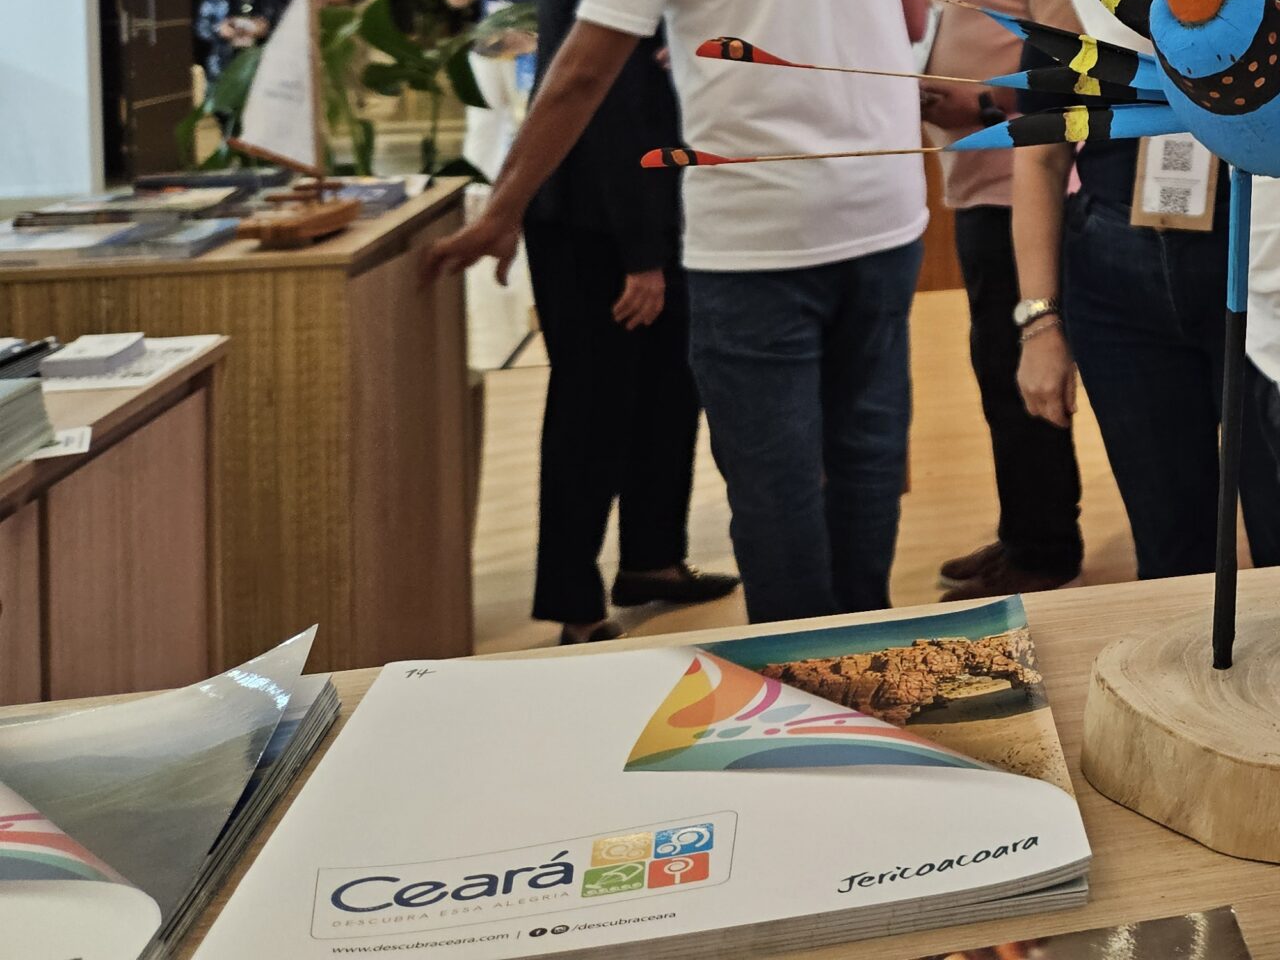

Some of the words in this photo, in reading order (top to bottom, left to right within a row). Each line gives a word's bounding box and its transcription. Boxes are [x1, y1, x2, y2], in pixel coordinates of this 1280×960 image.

[330, 850, 575, 913] Ceará
[837, 836, 1040, 894] Jericoacoara
[331, 912, 430, 929] DESCUBRA
[439, 905, 483, 918] ESSA
[493, 891, 571, 909] ALEGRIA
[331, 932, 510, 954] www.descubraceara.com
